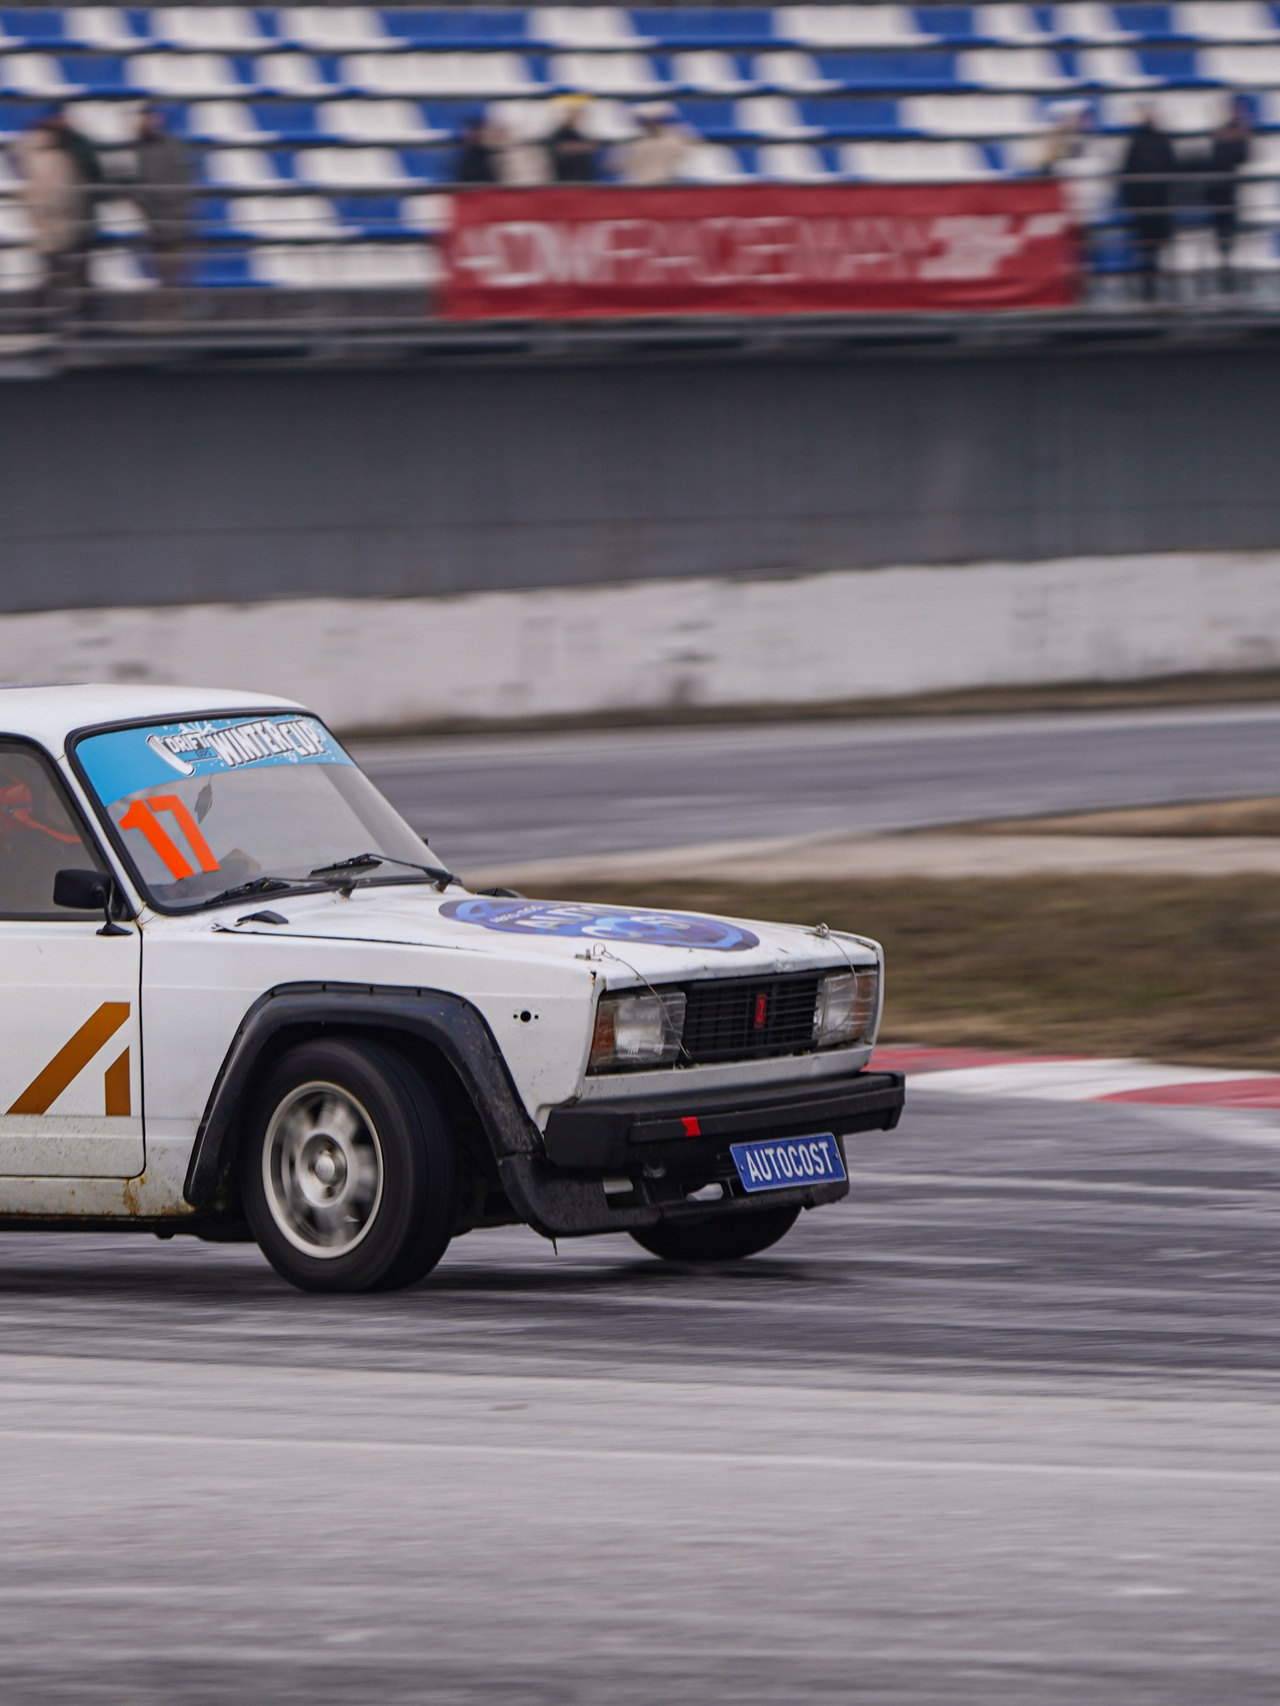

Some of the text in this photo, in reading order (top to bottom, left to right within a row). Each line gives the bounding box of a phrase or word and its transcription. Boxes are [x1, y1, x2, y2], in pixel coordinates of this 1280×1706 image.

[207, 720, 327, 768] WINTER CUP
[118, 794, 220, 880] 17
[745, 1141, 834, 1183] AUTOCOST
